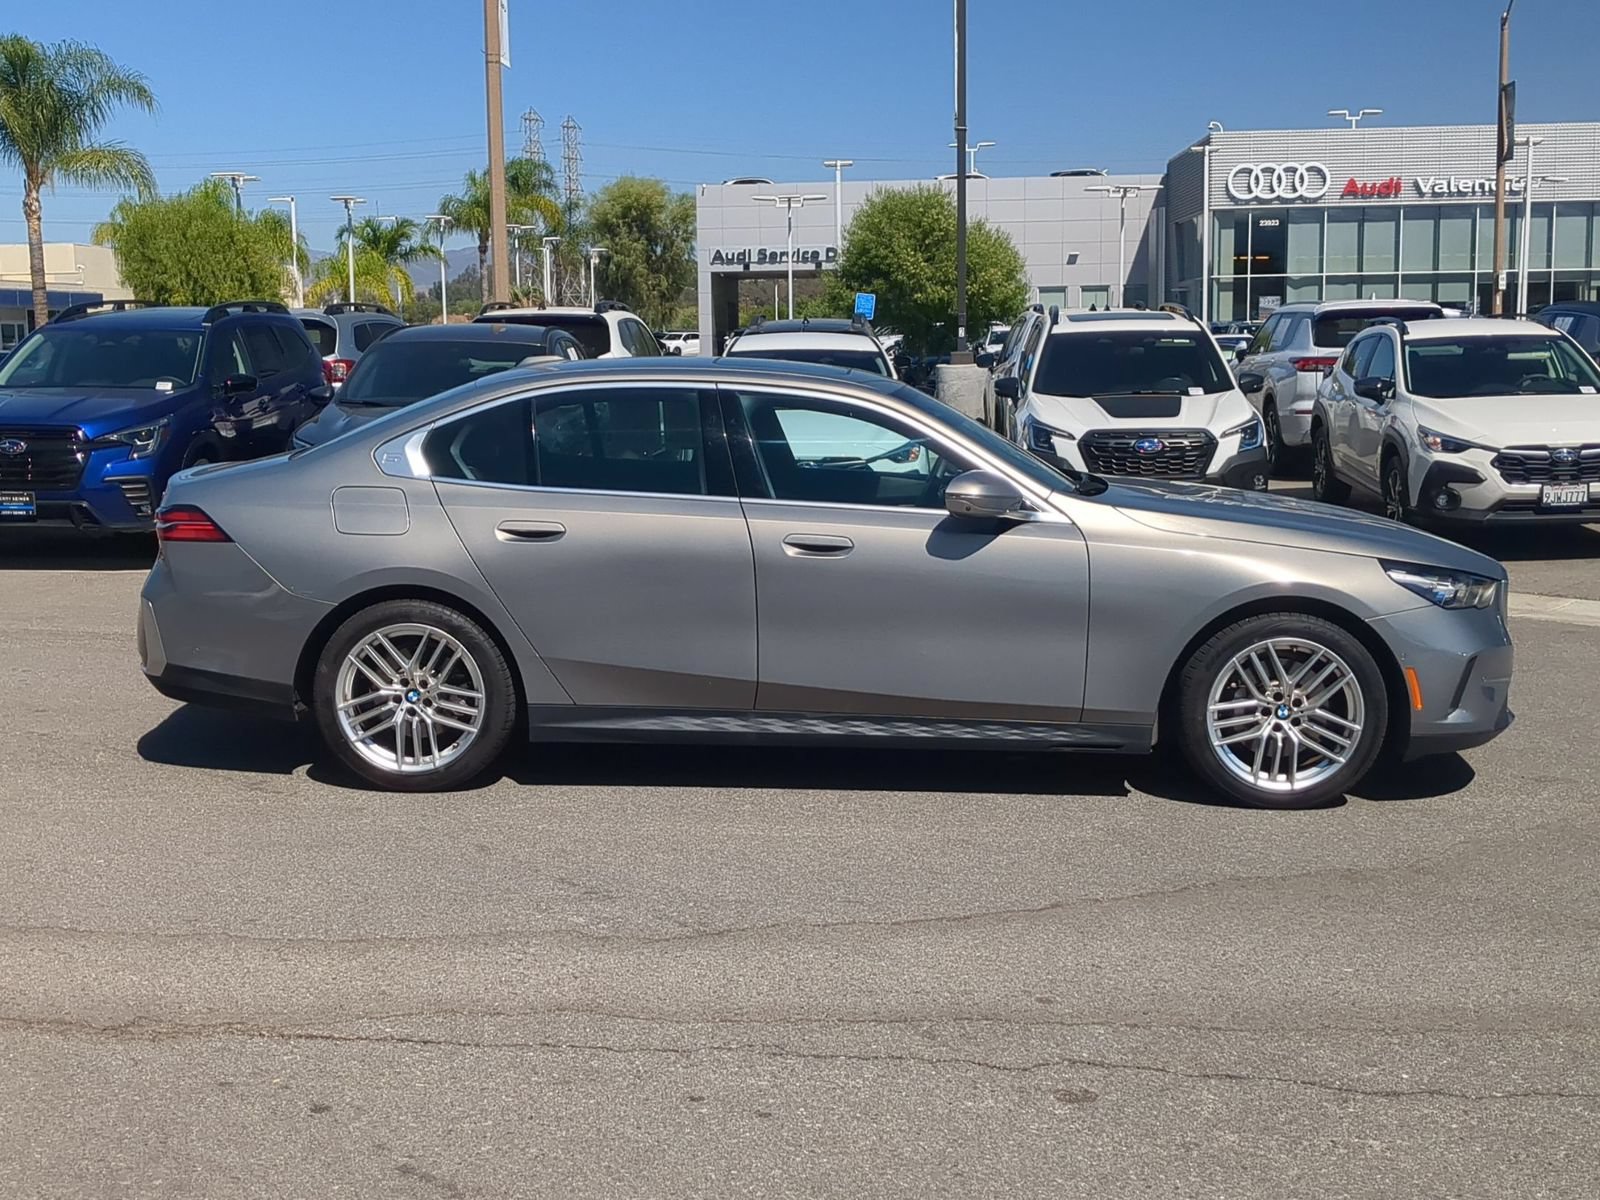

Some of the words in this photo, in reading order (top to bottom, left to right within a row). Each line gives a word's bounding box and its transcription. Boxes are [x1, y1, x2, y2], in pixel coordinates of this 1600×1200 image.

[1343, 176, 1402, 195] Audi
[710, 249, 752, 265] Audi
[756, 248, 820, 264] Service
